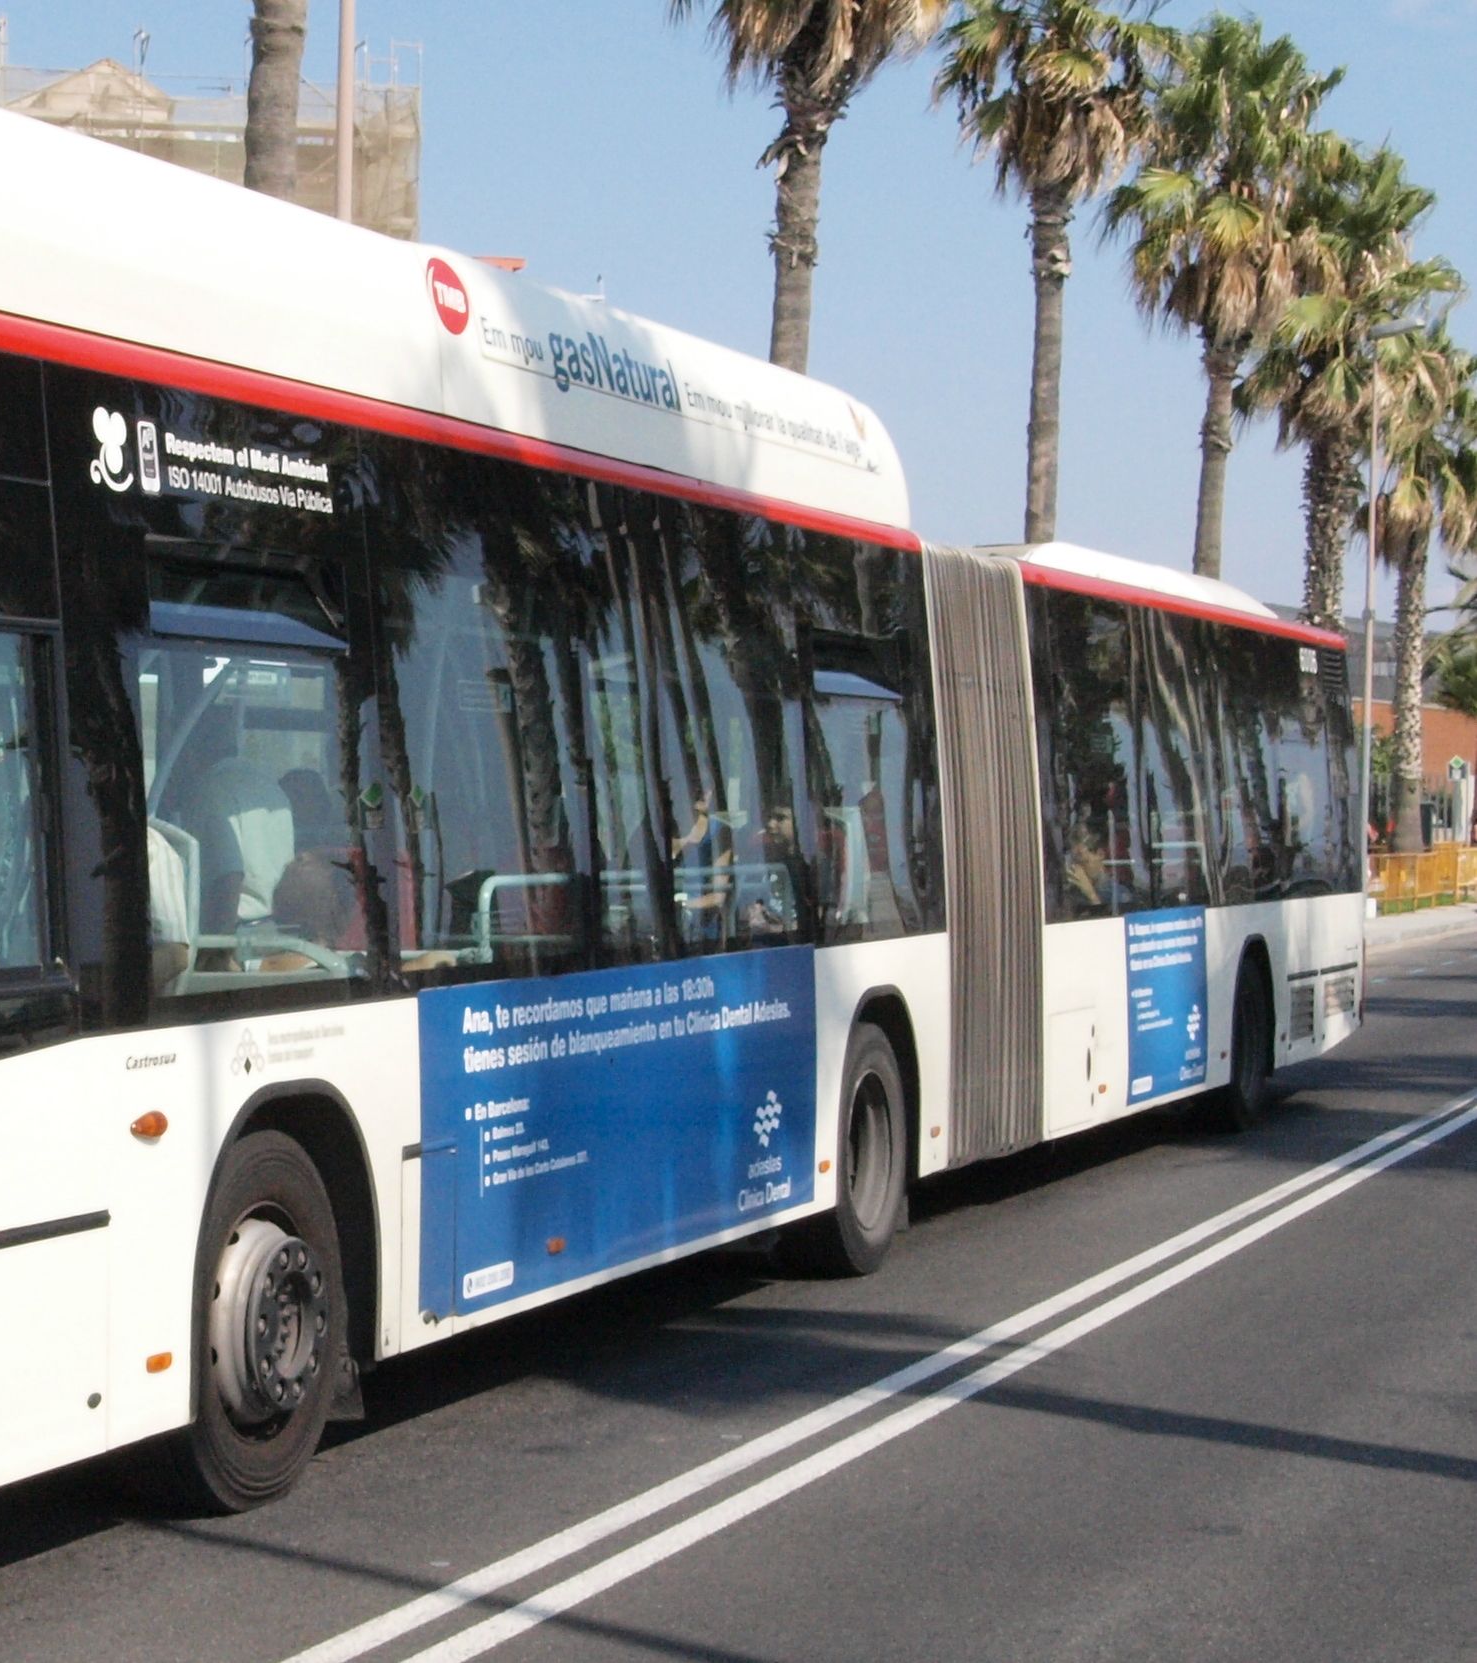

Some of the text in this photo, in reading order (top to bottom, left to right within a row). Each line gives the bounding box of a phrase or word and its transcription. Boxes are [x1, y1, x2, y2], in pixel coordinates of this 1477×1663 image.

[480, 317, 682, 411] Em mou gasNatural
[165, 432, 234, 465] Respectem
[237, 447, 248, 468] el
[250, 449, 280, 473] Medi
[281, 455, 329, 482] Ambient
[168, 466, 190, 490] ISO
[192, 470, 223, 494] 14001
[225, 476, 279, 505] Autobusos
[297, 487, 333, 513] Pública
[462, 1007, 494, 1035] Ana,
[496, 1004, 511, 1029] te
[512, 997, 583, 1027] recordamos
[586, 994, 608, 1020] que
[610, 987, 652, 1012] mañana
[654, 988, 662, 1005] a
[664, 982, 679, 1003] las
[125, 1052, 177, 1070] Castrosua
[464, 1046, 505, 1074] tienes
[508, 1034, 548, 1067] sesión
[550, 1033, 566, 1058] de
[568, 1020, 657, 1056] blanqueamiento
[659, 1021, 672, 1039] en
[674, 1017, 685, 1037] tu
[722, 1003, 753, 1029] Dental
